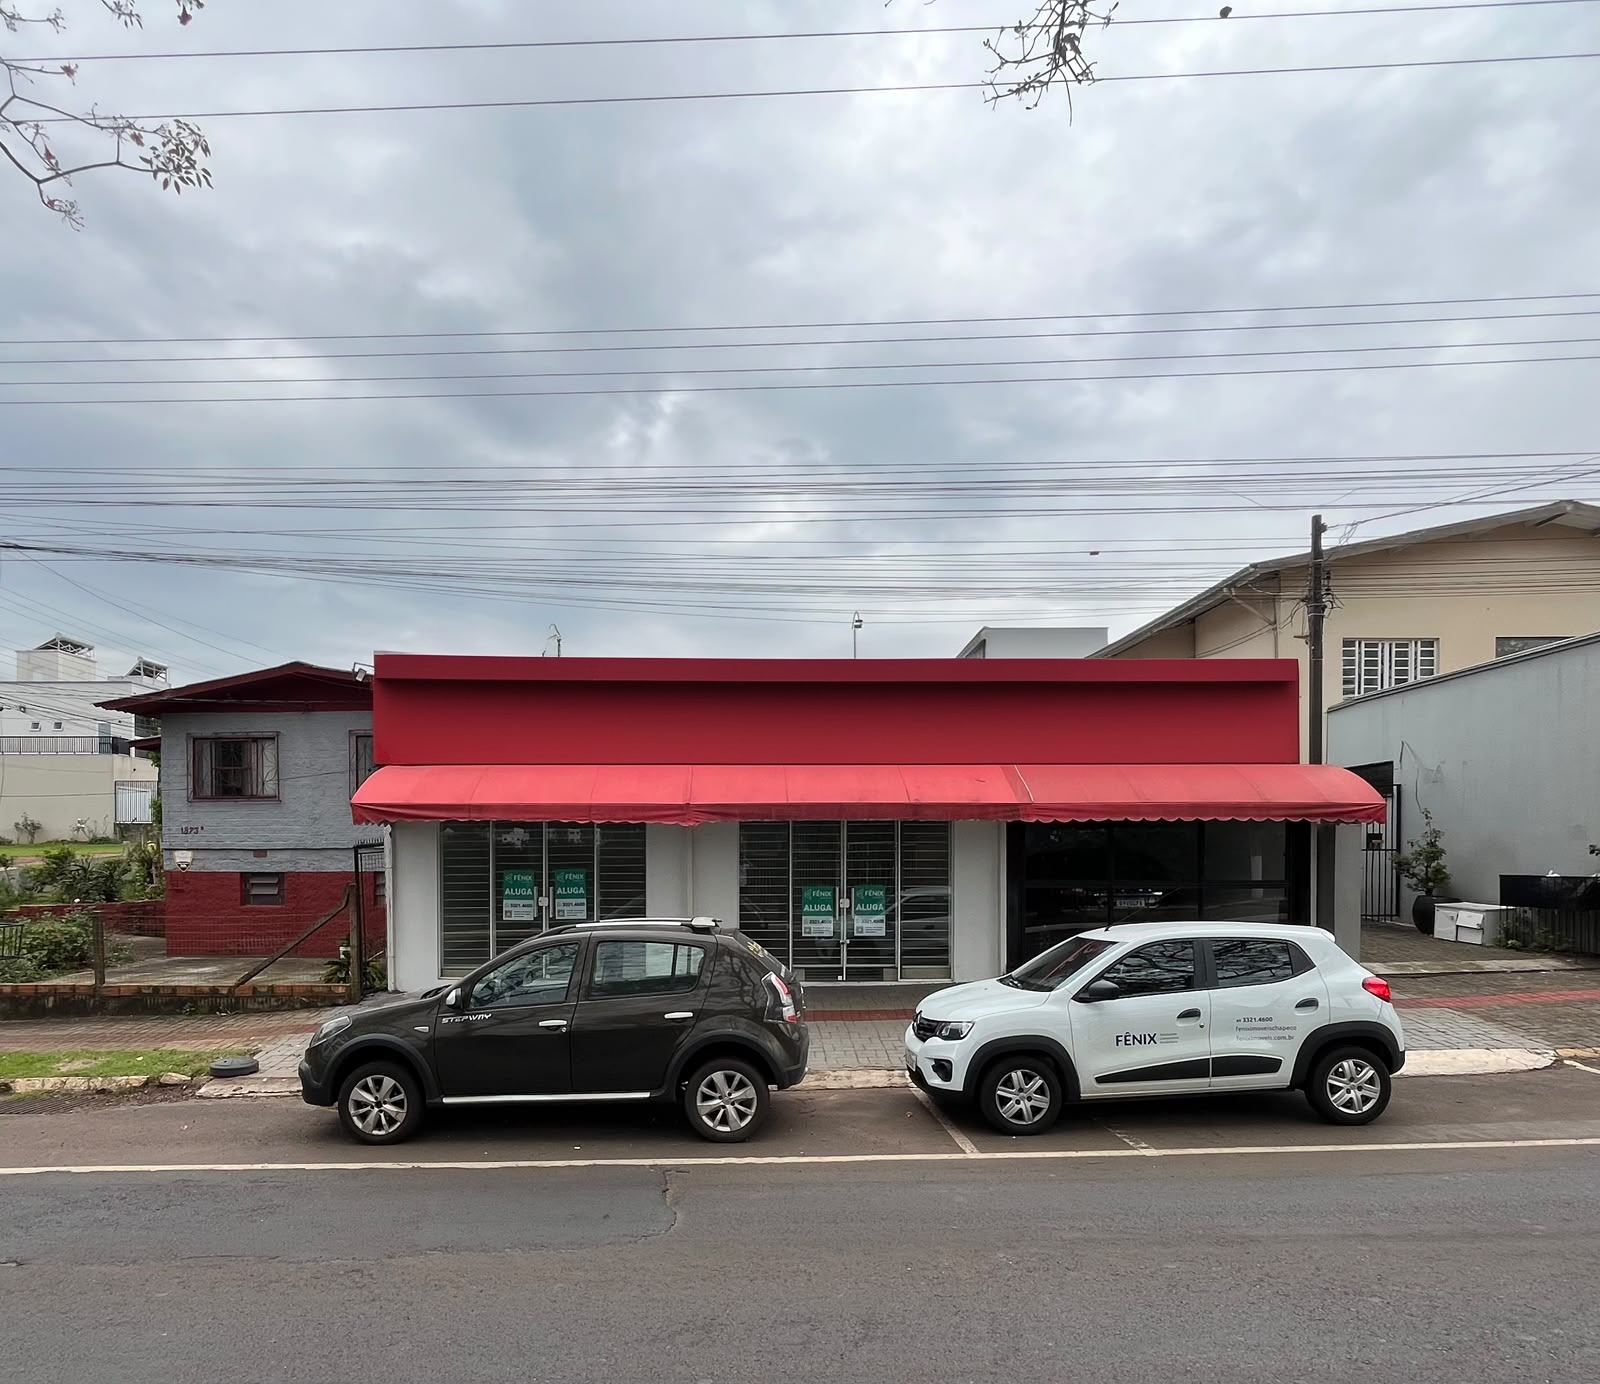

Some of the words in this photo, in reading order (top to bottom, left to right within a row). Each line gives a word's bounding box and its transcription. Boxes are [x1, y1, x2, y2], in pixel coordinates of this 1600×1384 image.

[504, 887, 533, 896] ALUGA
[556, 886, 585, 895] ALUGA
[803, 904, 833, 912] ALUGA
[855, 903, 885, 911] ALUGA
[441, 1013, 492, 1024] STEPWAY
[1115, 1031, 1157, 1047] FÊNIX
